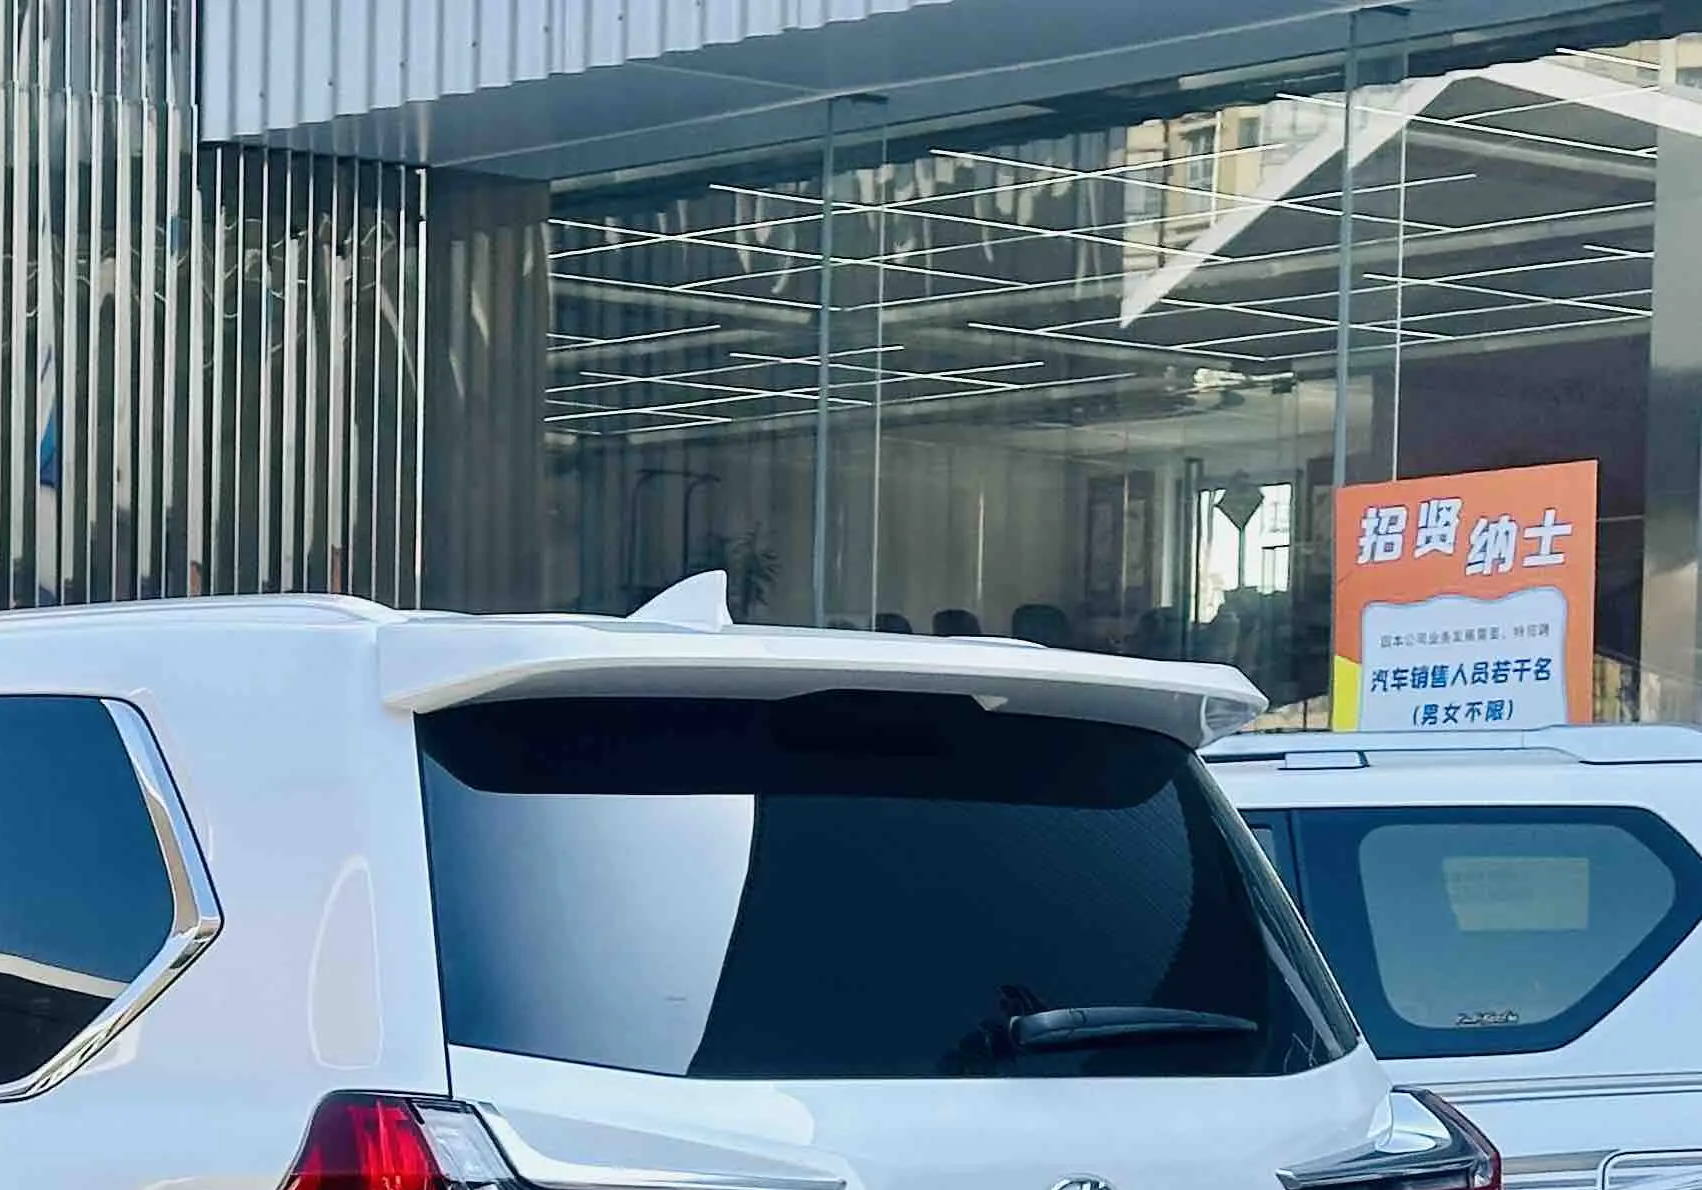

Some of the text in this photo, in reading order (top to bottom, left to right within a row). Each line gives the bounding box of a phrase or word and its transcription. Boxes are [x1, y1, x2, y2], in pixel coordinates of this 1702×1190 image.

[1356, 497, 1572, 576] 招贤纳士
[1370, 657, 1552, 693] 汽车销售人员若干名
